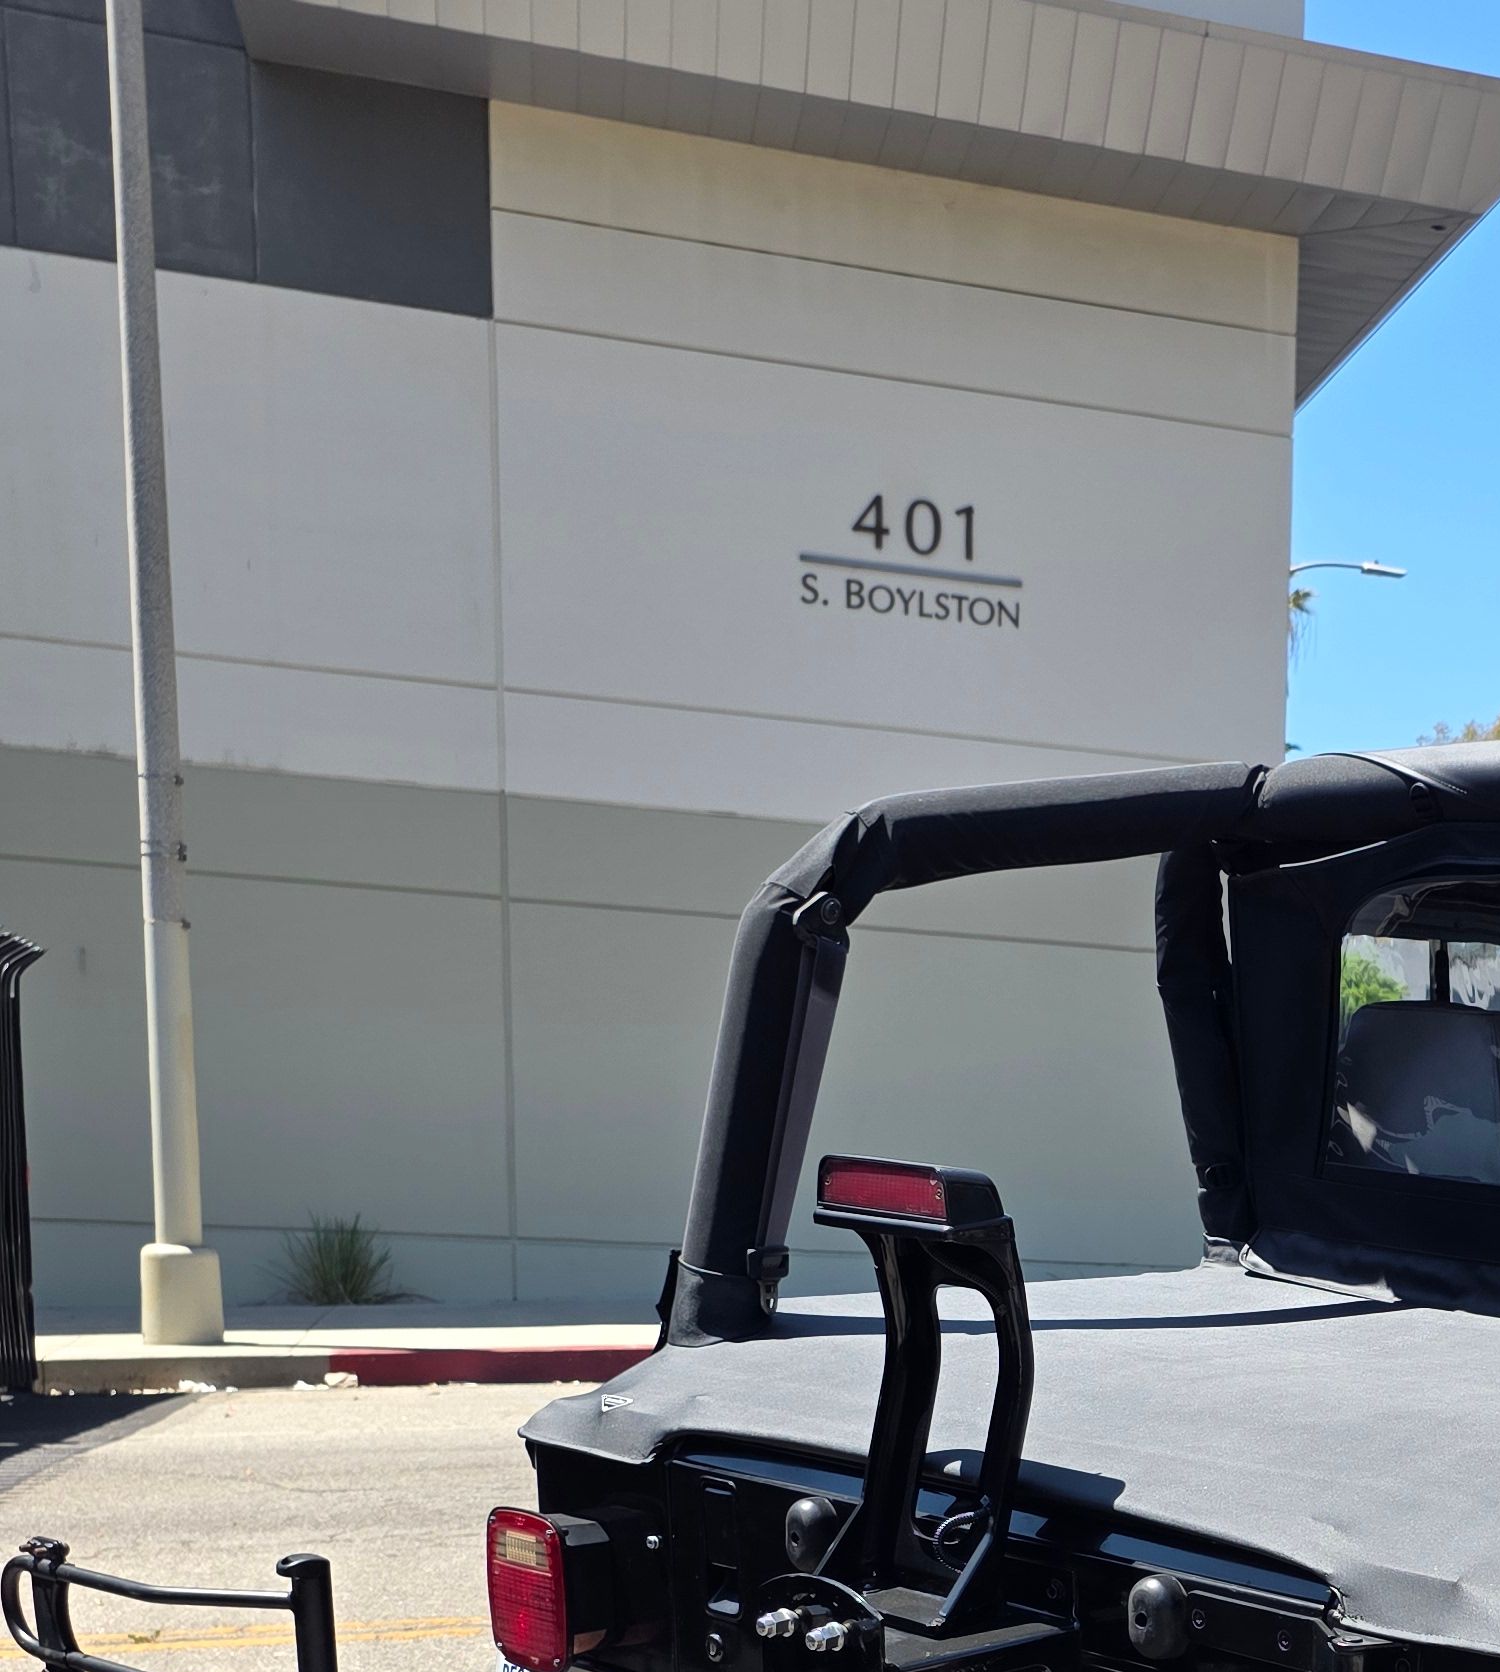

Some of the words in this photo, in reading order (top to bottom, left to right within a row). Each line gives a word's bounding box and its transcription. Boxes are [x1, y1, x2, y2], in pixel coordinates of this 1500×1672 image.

[851, 494, 975, 561] 401
[801, 573, 828, 606] S.
[845, 578, 1021, 629] BOYLSTON
